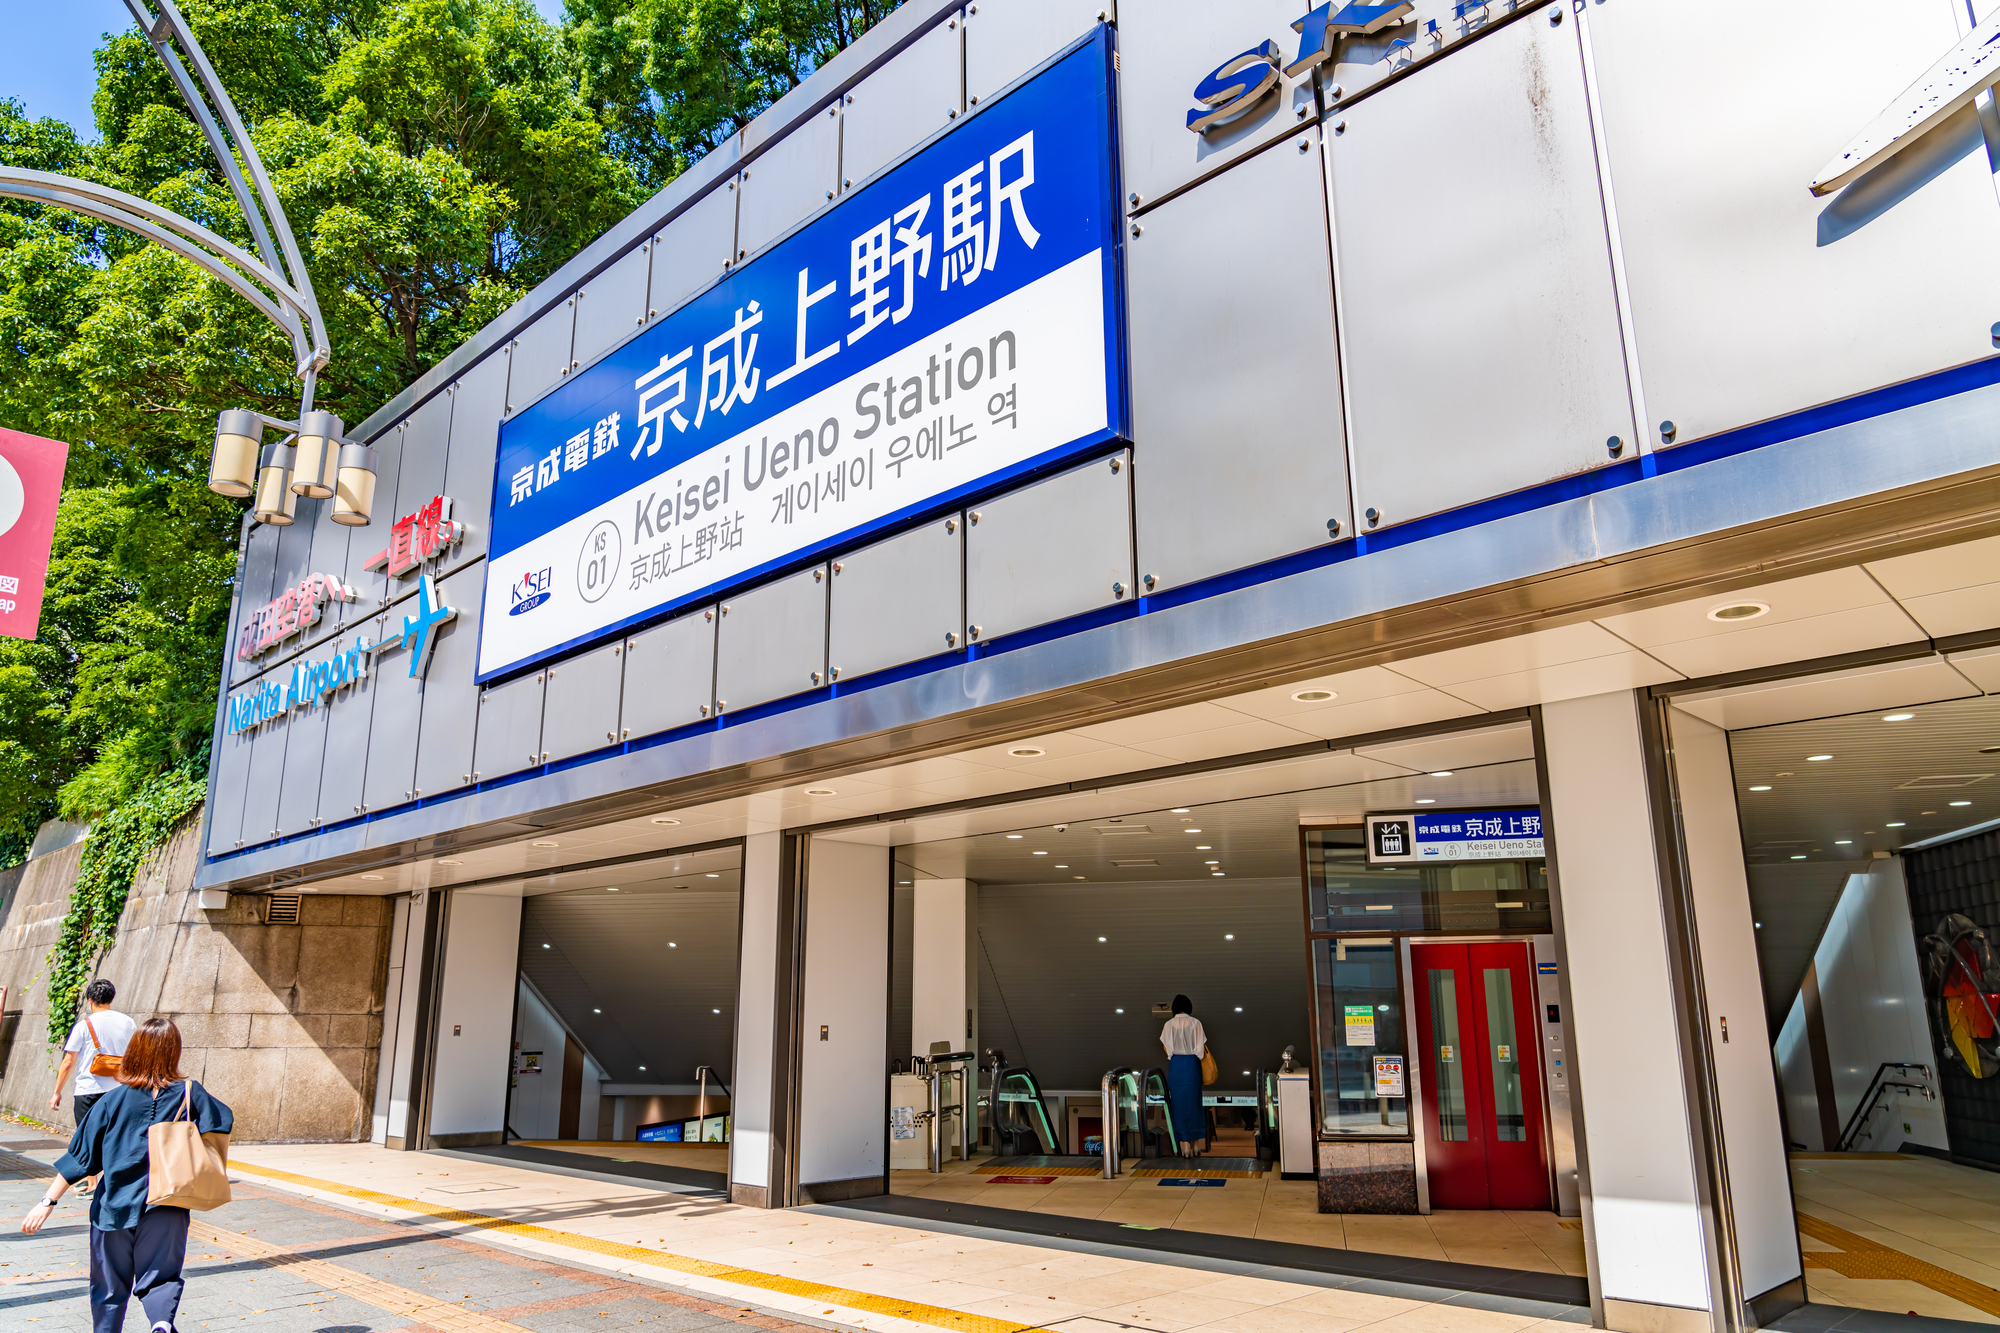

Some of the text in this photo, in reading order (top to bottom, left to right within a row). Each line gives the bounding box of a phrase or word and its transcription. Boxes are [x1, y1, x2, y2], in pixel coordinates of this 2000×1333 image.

[509, 130, 1041, 507] 京成電鉄 京成上野駅
[634, 330, 1016, 545] Keisei Ueno Station
[771, 382, 1017, 525] 게이세이 우에노 역
[594, 531, 607, 554] KS
[628, 510, 745, 591] 京成上野站
[586, 554, 607, 590] 01
[519, 596, 540, 613] GROUP
[228, 636, 364, 735] Narita Airport
[1418, 816, 1543, 837] 京成電鉄 京成上野
[1467, 839, 1544, 851] Keisei Ueno Sta
